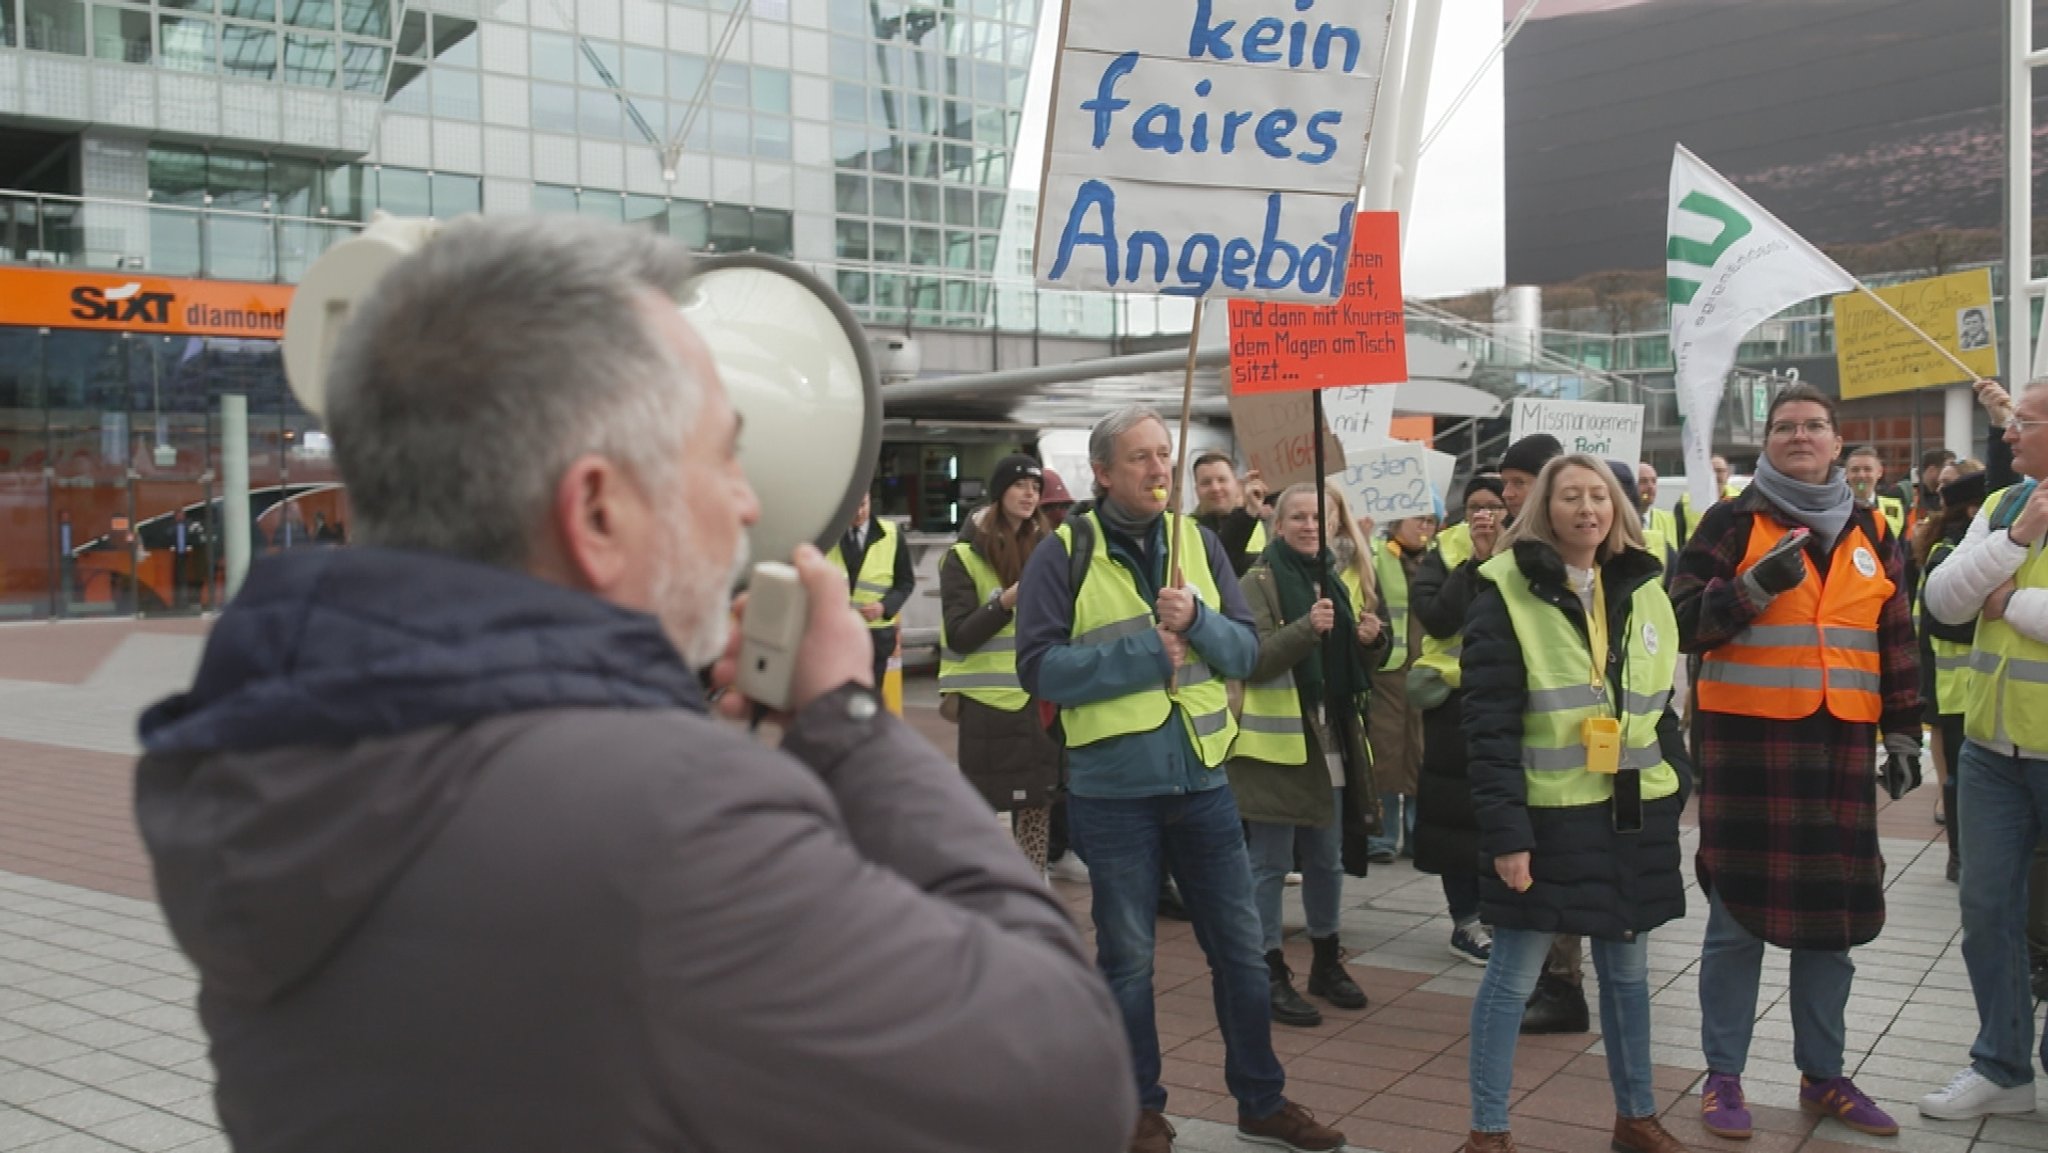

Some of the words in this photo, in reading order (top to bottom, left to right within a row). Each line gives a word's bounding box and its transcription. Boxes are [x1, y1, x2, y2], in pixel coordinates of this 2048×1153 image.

[1189, 0, 1361, 73] kein
[1080, 51, 1342, 164] faires
[1048, 180, 1355, 297] Angebot
[1349, 244, 1383, 268] hen
[1345, 274, 1378, 301] ast,
[187, 303, 286, 330] diamond
[1232, 302, 1264, 328] und
[1268, 305, 1307, 326] dann
[1313, 306, 1338, 326] mit
[1344, 304, 1399, 326] Knurren
[1235, 334, 1270, 357] dem
[1275, 331, 1327, 360] Magen
[1332, 338, 1356, 354] am
[1356, 331, 1396, 354] Tisch
[1334, 412, 1374, 433] mit
[1575, 436, 1612, 455] Boni
